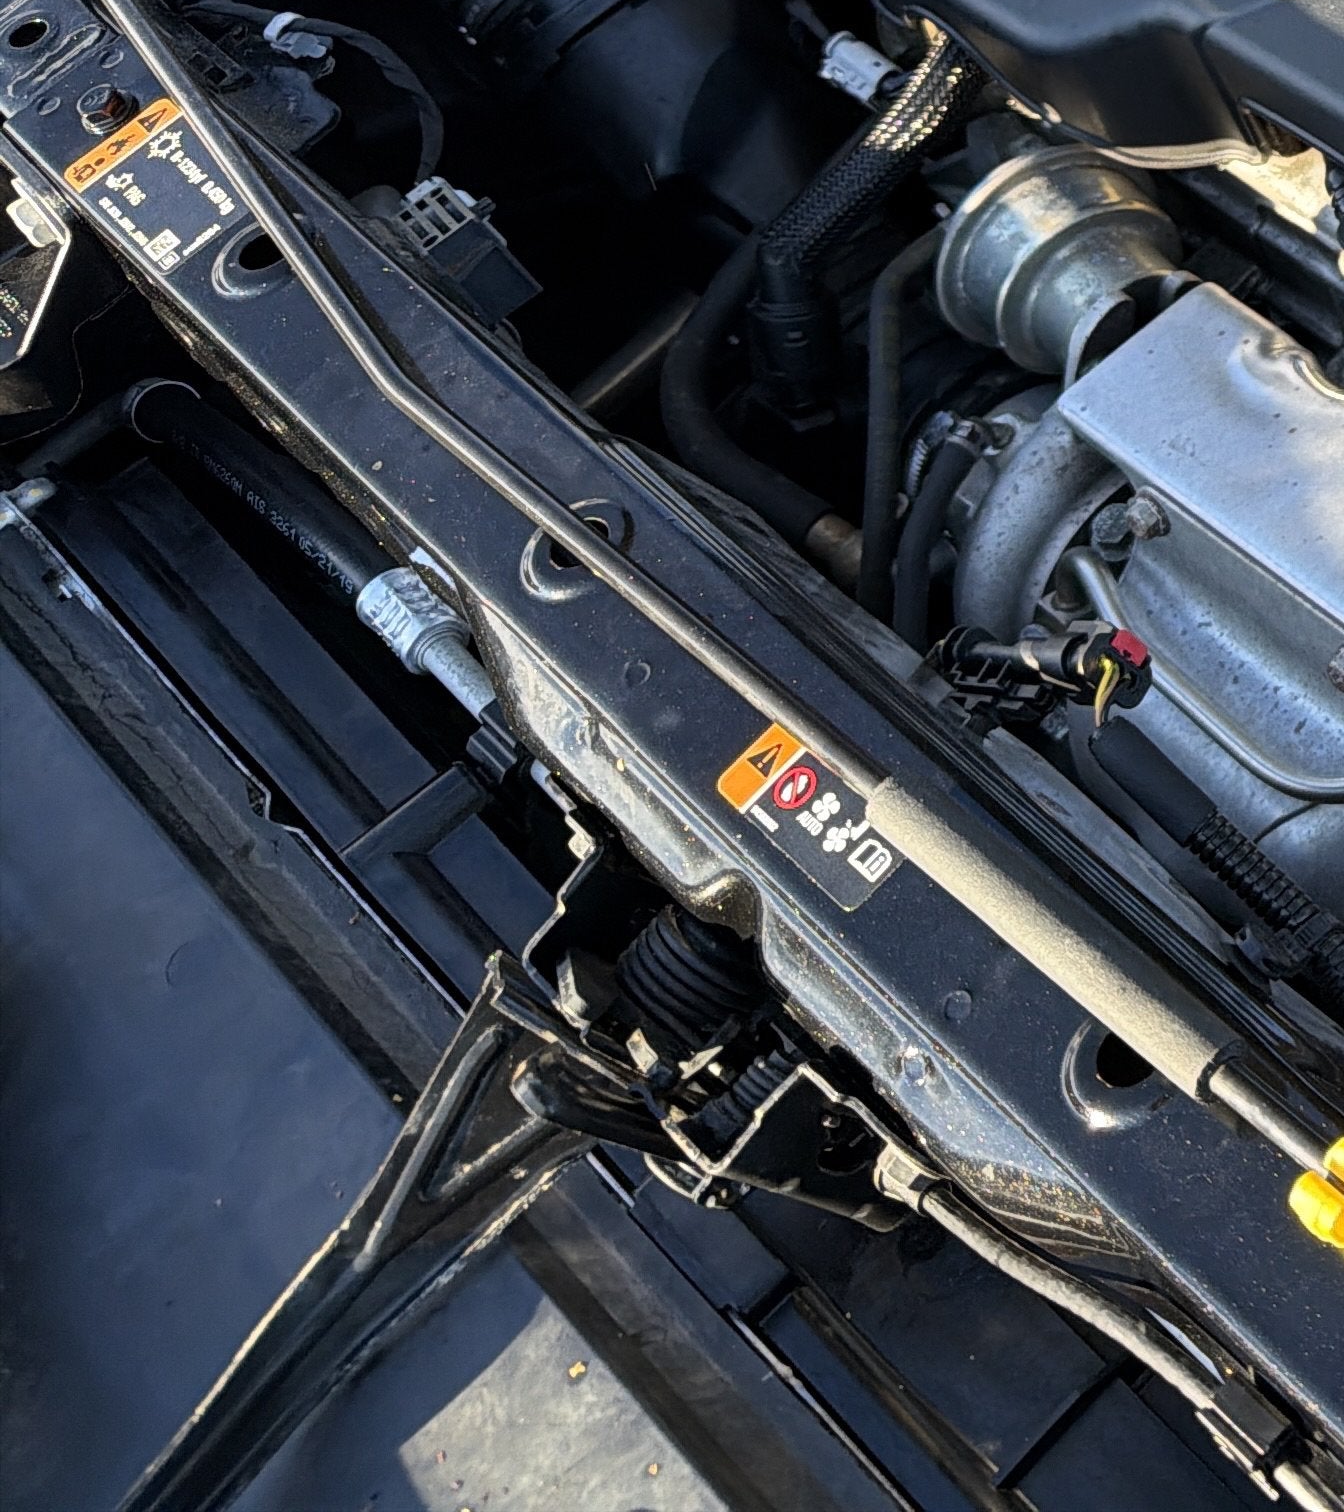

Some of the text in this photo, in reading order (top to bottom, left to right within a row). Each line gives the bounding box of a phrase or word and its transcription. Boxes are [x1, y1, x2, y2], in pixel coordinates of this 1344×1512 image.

[123, 185, 147, 206] PAG
[218, 197, 236, 216] kg
[794, 807, 825, 838] AUTO
